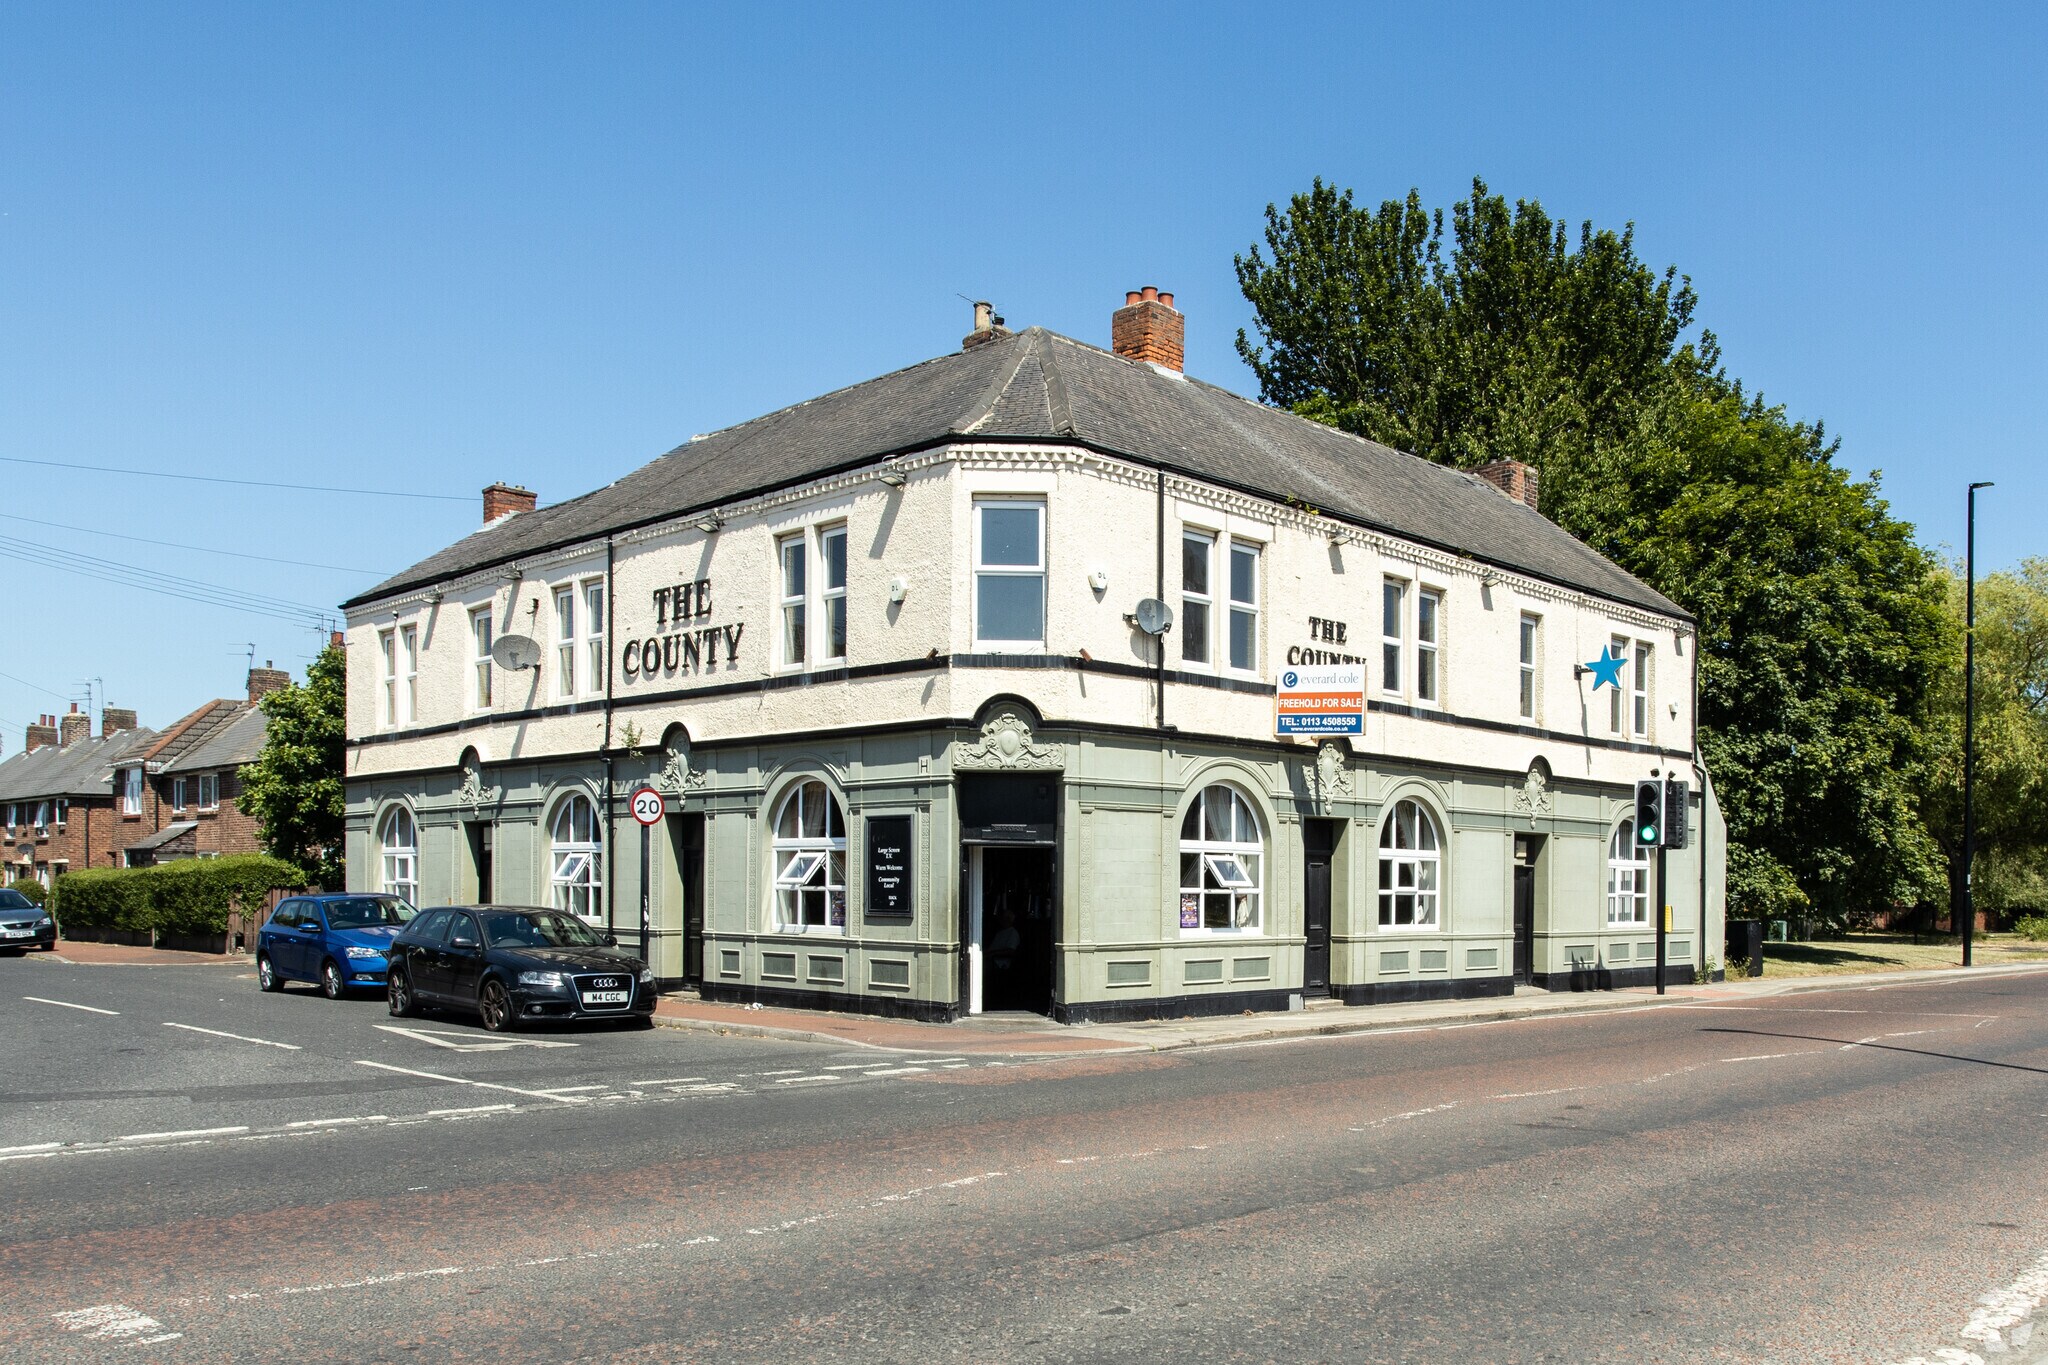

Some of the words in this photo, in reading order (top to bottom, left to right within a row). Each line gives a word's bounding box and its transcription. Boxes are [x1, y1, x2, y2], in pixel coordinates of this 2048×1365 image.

[653, 578, 712, 623] THE
[1308, 616, 1347, 643] THE
[623, 622, 744, 675] COUNTY
[1300, 672, 1336, 684] everard
[1338, 672, 1359, 684] cole
[1279, 698, 1321, 708] FREEHOLD
[1322, 698, 1339, 708] FOR
[1340, 698, 1362, 708] SALE
[1280, 717, 1300, 726] TEL:
[1301, 717, 1320, 726] 0113
[636, 799, 660, 814] 20
[605, 993, 620, 1001] CGC
